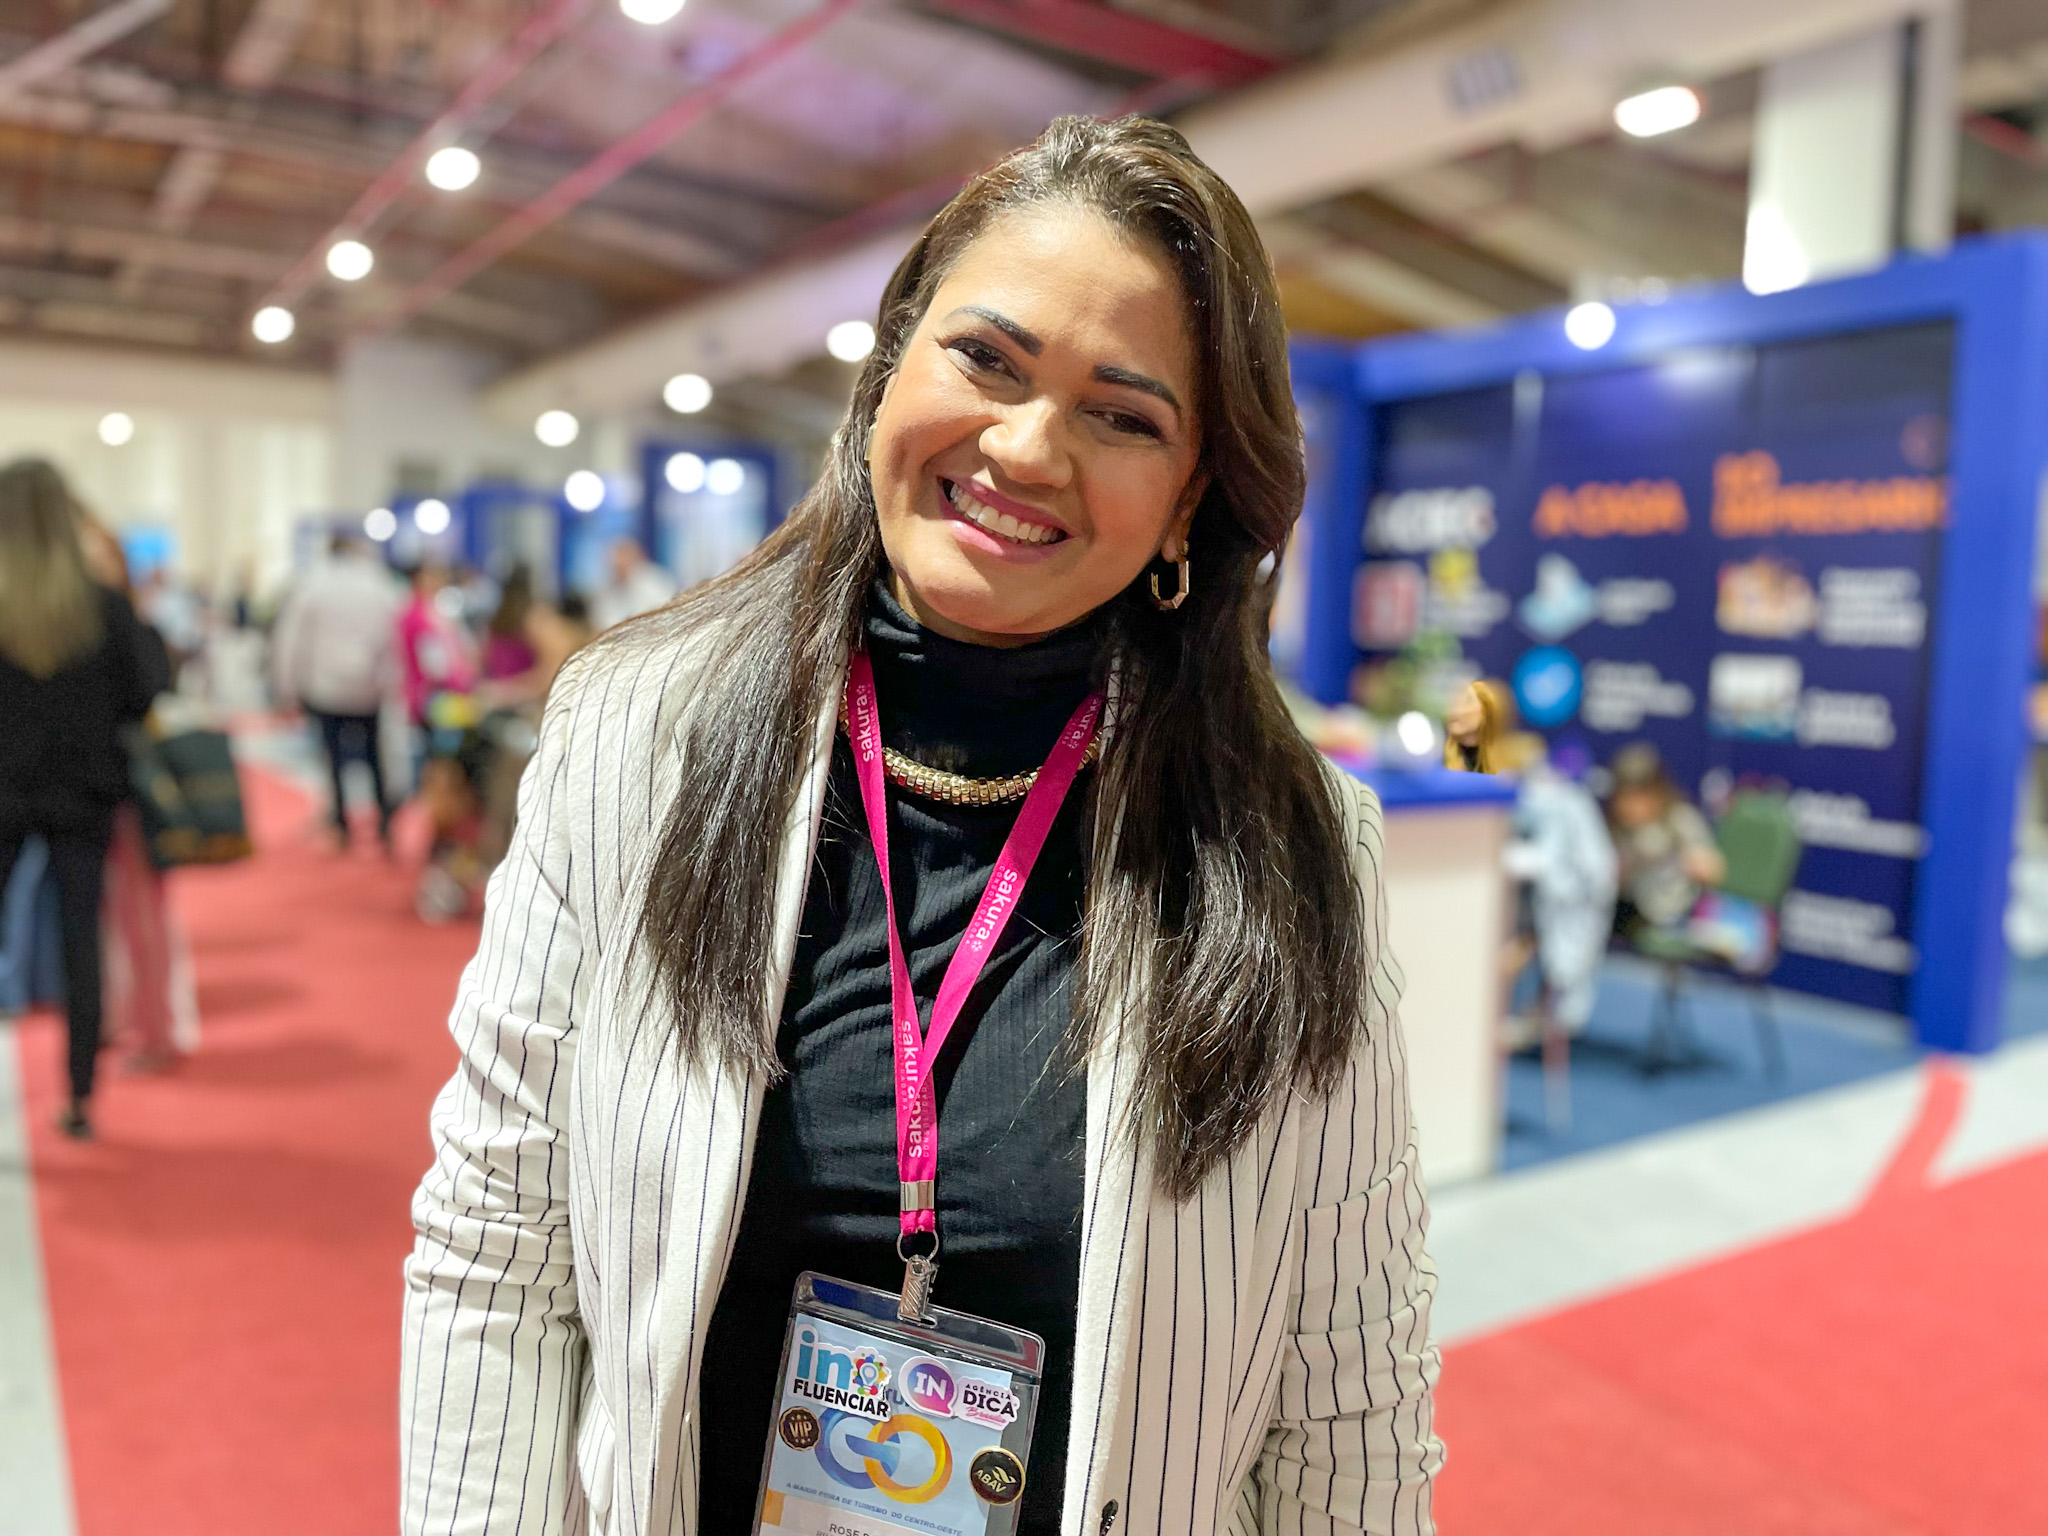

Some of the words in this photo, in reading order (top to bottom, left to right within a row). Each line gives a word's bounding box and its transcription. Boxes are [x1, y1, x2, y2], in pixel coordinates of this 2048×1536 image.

[856, 694, 875, 762] sakura
[976, 869, 1018, 940] sakura
[901, 1020, 919, 1099] sakura
[793, 1379, 889, 1418] FLUENCIAR
[914, 1371, 947, 1401] IN
[963, 1390, 1015, 1418] DICA
[788, 1421, 812, 1438] VIP
[975, 1469, 1007, 1493] ABAV
[855, 1501, 887, 1515] TURISMO
[891, 1511, 903, 1519] DO
